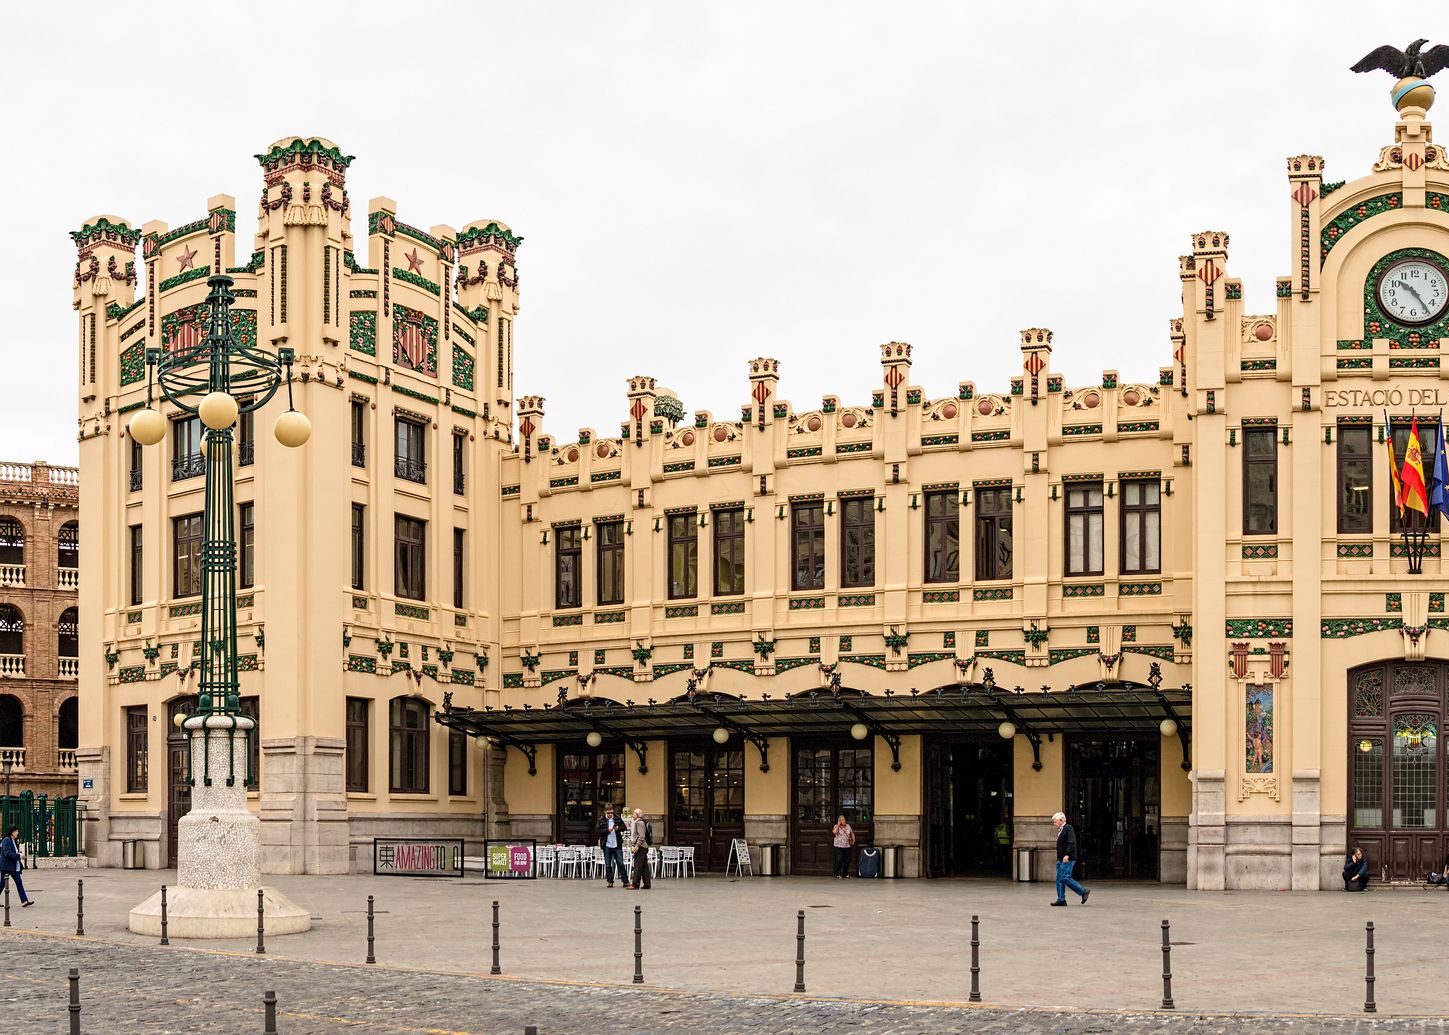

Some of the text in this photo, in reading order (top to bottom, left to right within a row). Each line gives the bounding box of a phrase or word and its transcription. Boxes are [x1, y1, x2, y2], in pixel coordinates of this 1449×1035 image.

[1410, 270, 1420, 278] 12
[1388, 289, 1395, 297] 9
[1391, 298, 1398, 306] 8
[1324, 385, 1402, 407] ESTACIÓ
[1408, 389, 1448, 406] DEL
[380, 845, 395, 869] 東
[395, 845, 459, 870] AMAZINGTOO
